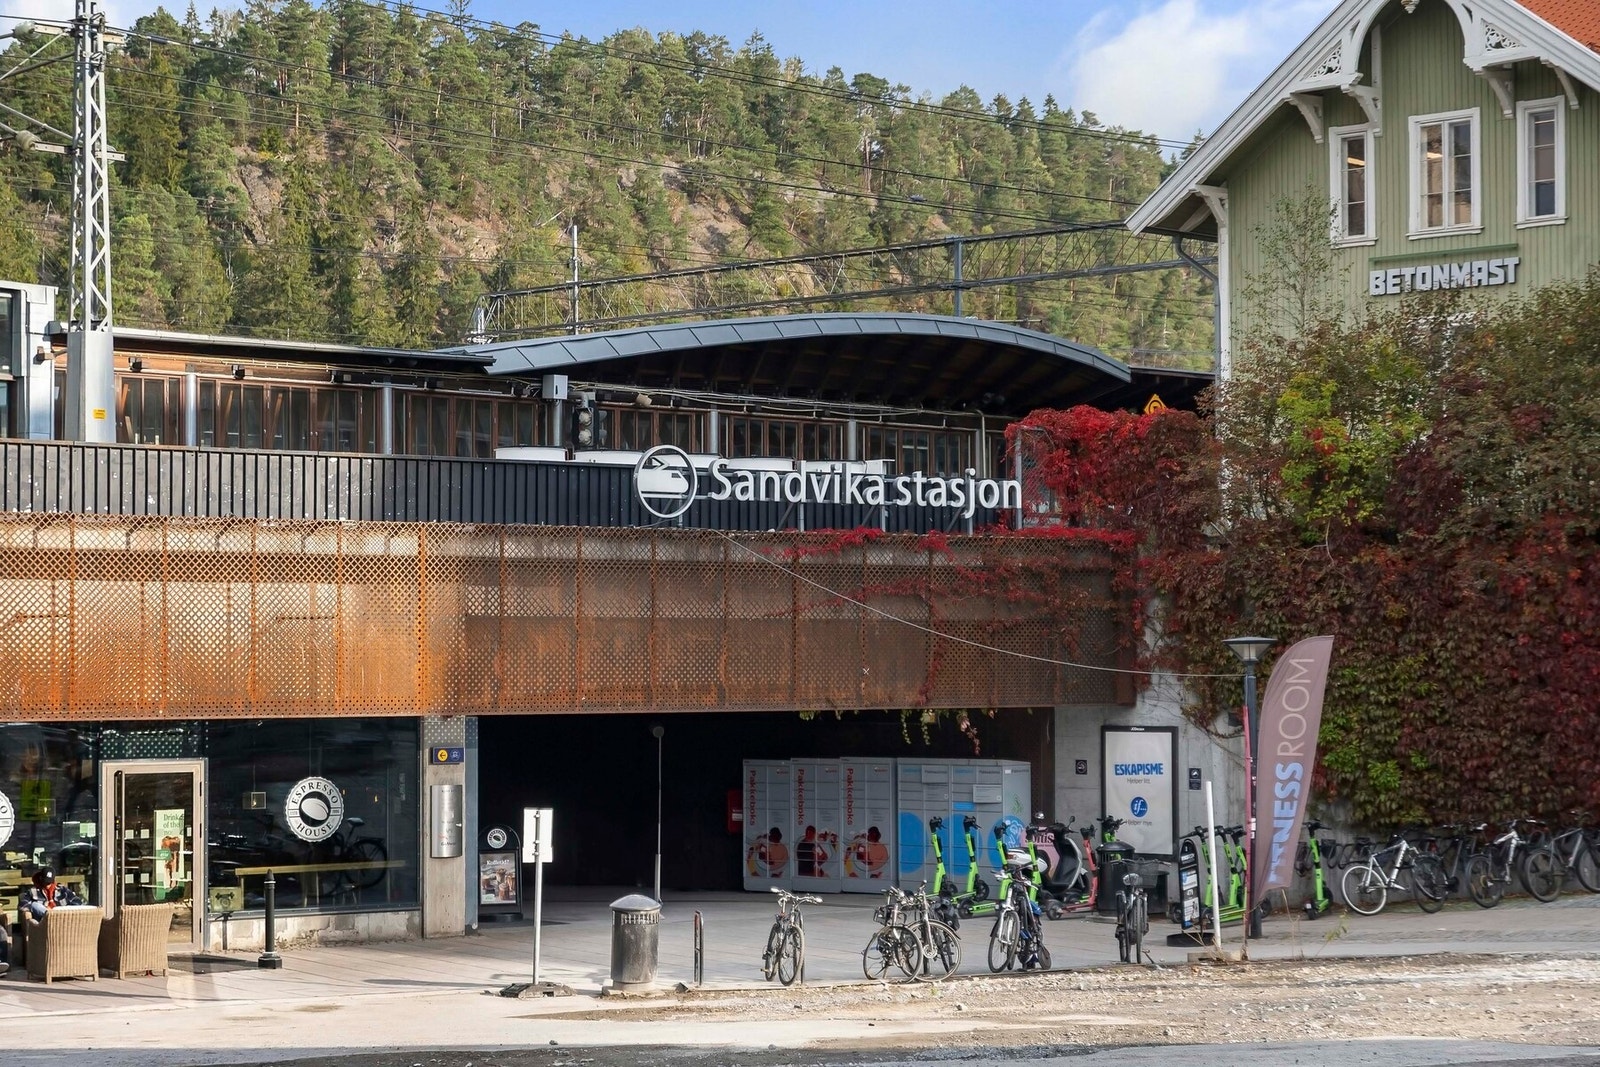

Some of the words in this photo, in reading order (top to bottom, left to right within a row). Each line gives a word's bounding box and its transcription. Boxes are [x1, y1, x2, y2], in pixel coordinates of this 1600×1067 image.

[1370, 257, 1520, 296] BETONMAST
[709, 458, 885, 505] Sandvika
[896, 467, 1022, 519] stasjon
[1276, 658, 1315, 757] ROOM
[1114, 763, 1163, 776] ESKAPISME
[291, 782, 338, 805] ESPRESSO
[297, 823, 333, 837] HOUSE
